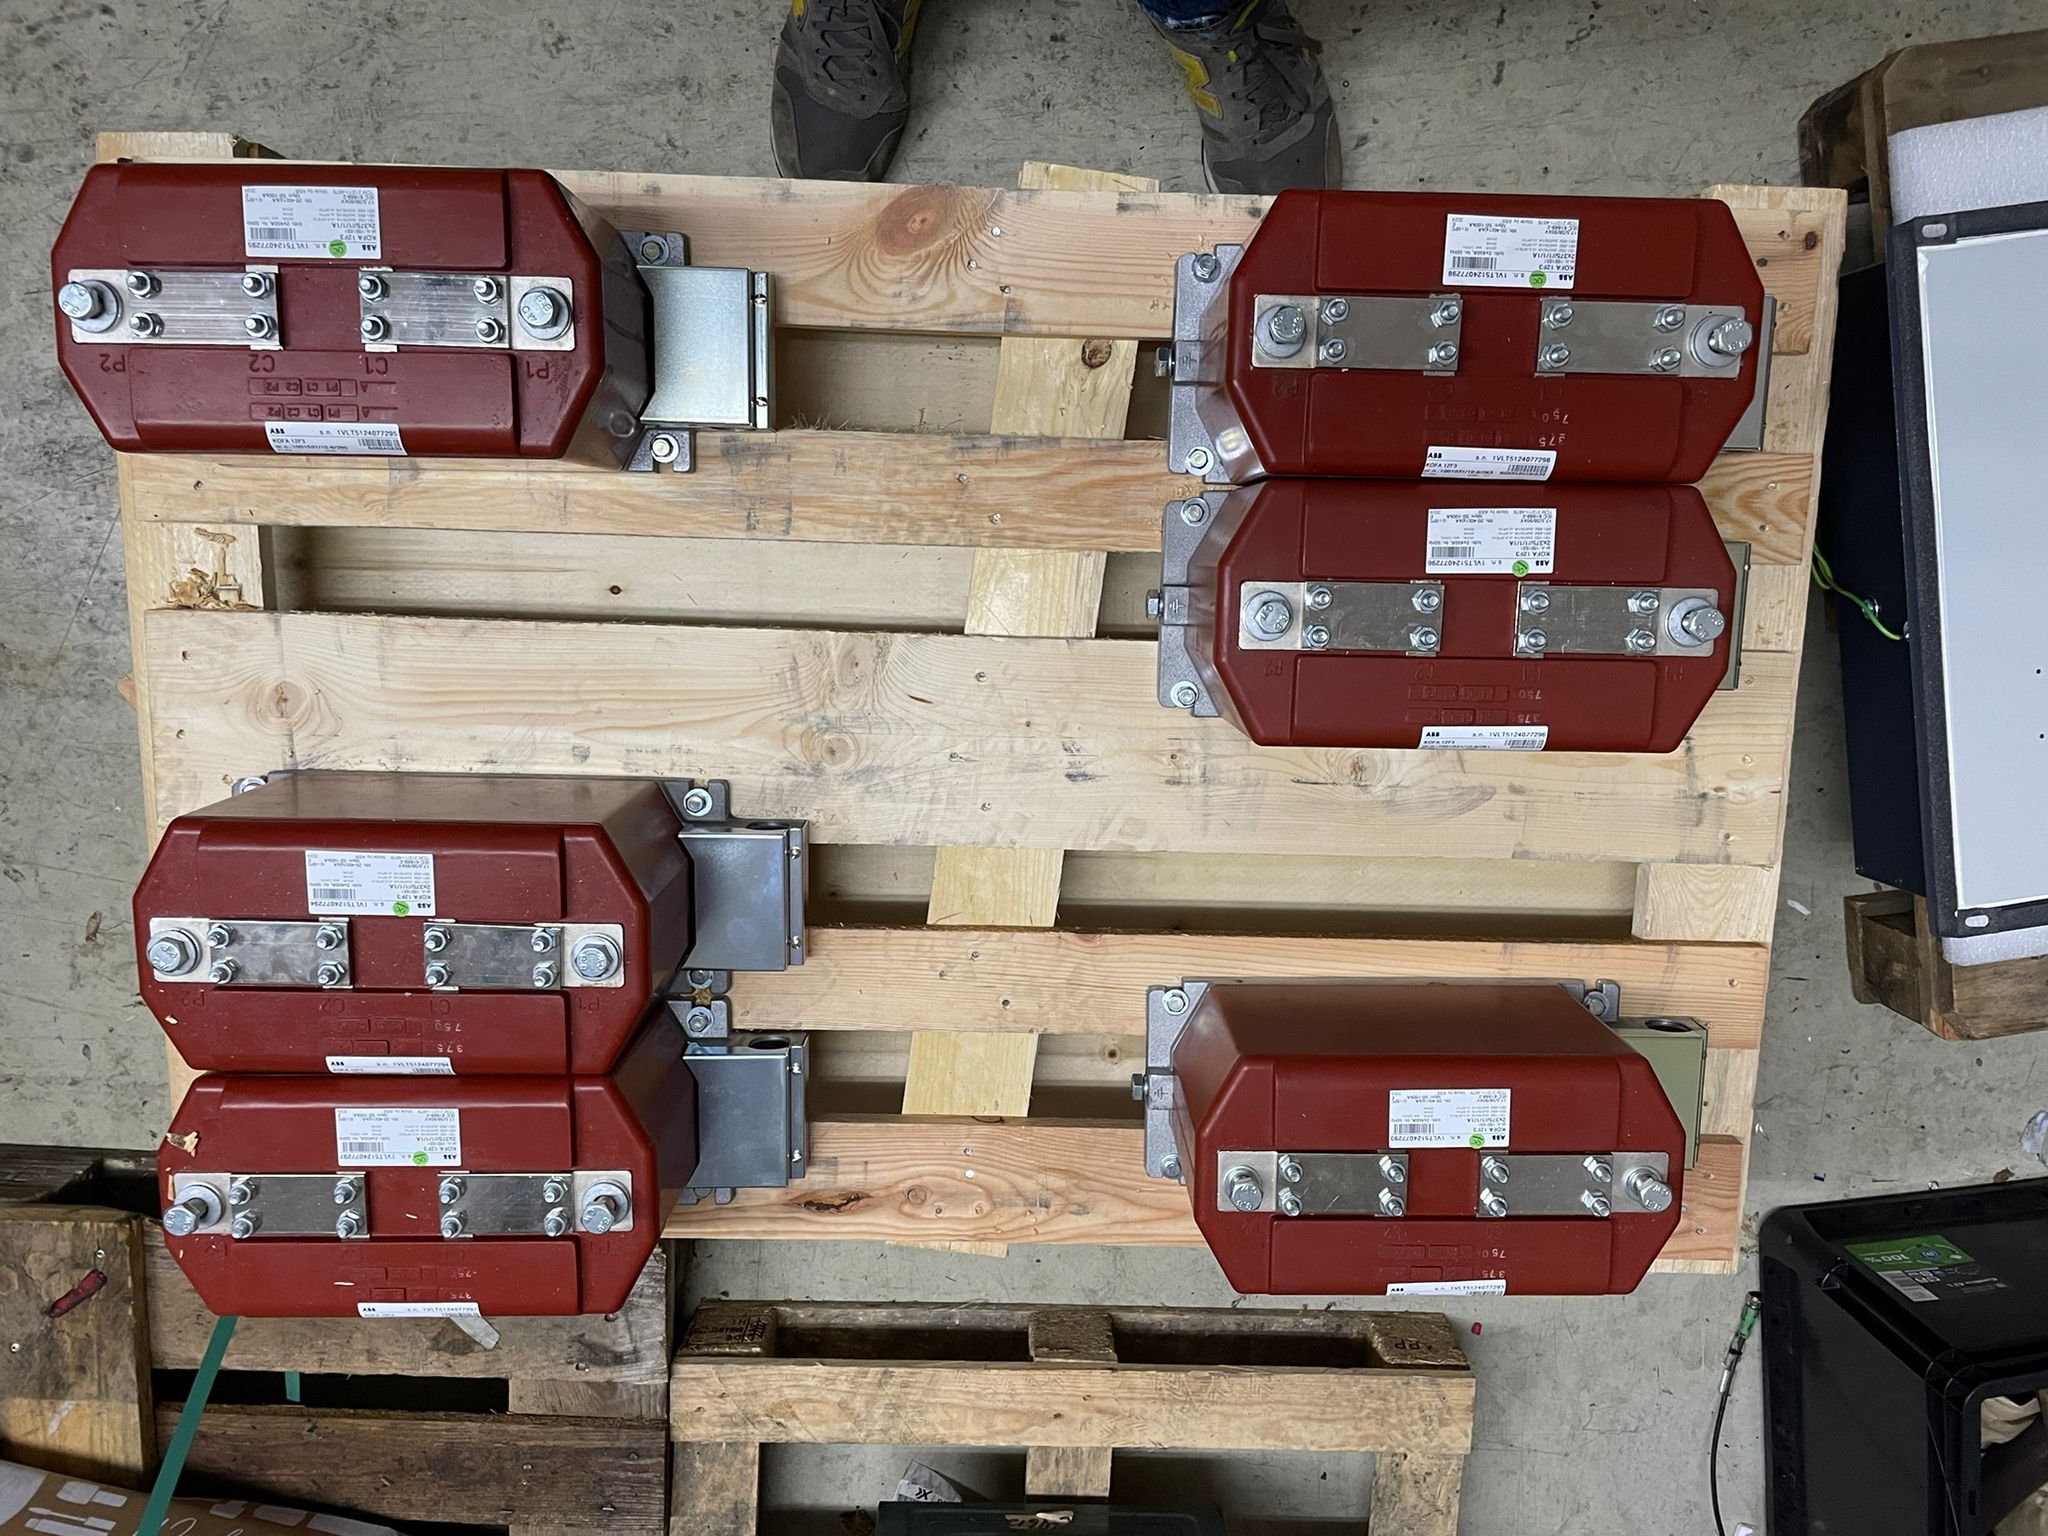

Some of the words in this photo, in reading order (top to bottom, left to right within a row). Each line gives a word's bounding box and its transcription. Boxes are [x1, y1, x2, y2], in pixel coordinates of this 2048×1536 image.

[99, 354, 126, 373] P2
[249, 355, 274, 373] C2
[364, 356, 388, 375] C1
[526, 361, 550, 379] P1
[1542, 410, 1568, 424] 750
[1539, 434, 1566, 447] 375
[1519, 690, 1542, 700] 750
[1518, 714, 1541, 723] 375
[434, 1023, 461, 1032] 750
[437, 1043, 464, 1053] 375
[1482, 1249, 1506, 1258] 750
[1482, 1270, 1506, 1278] 375
